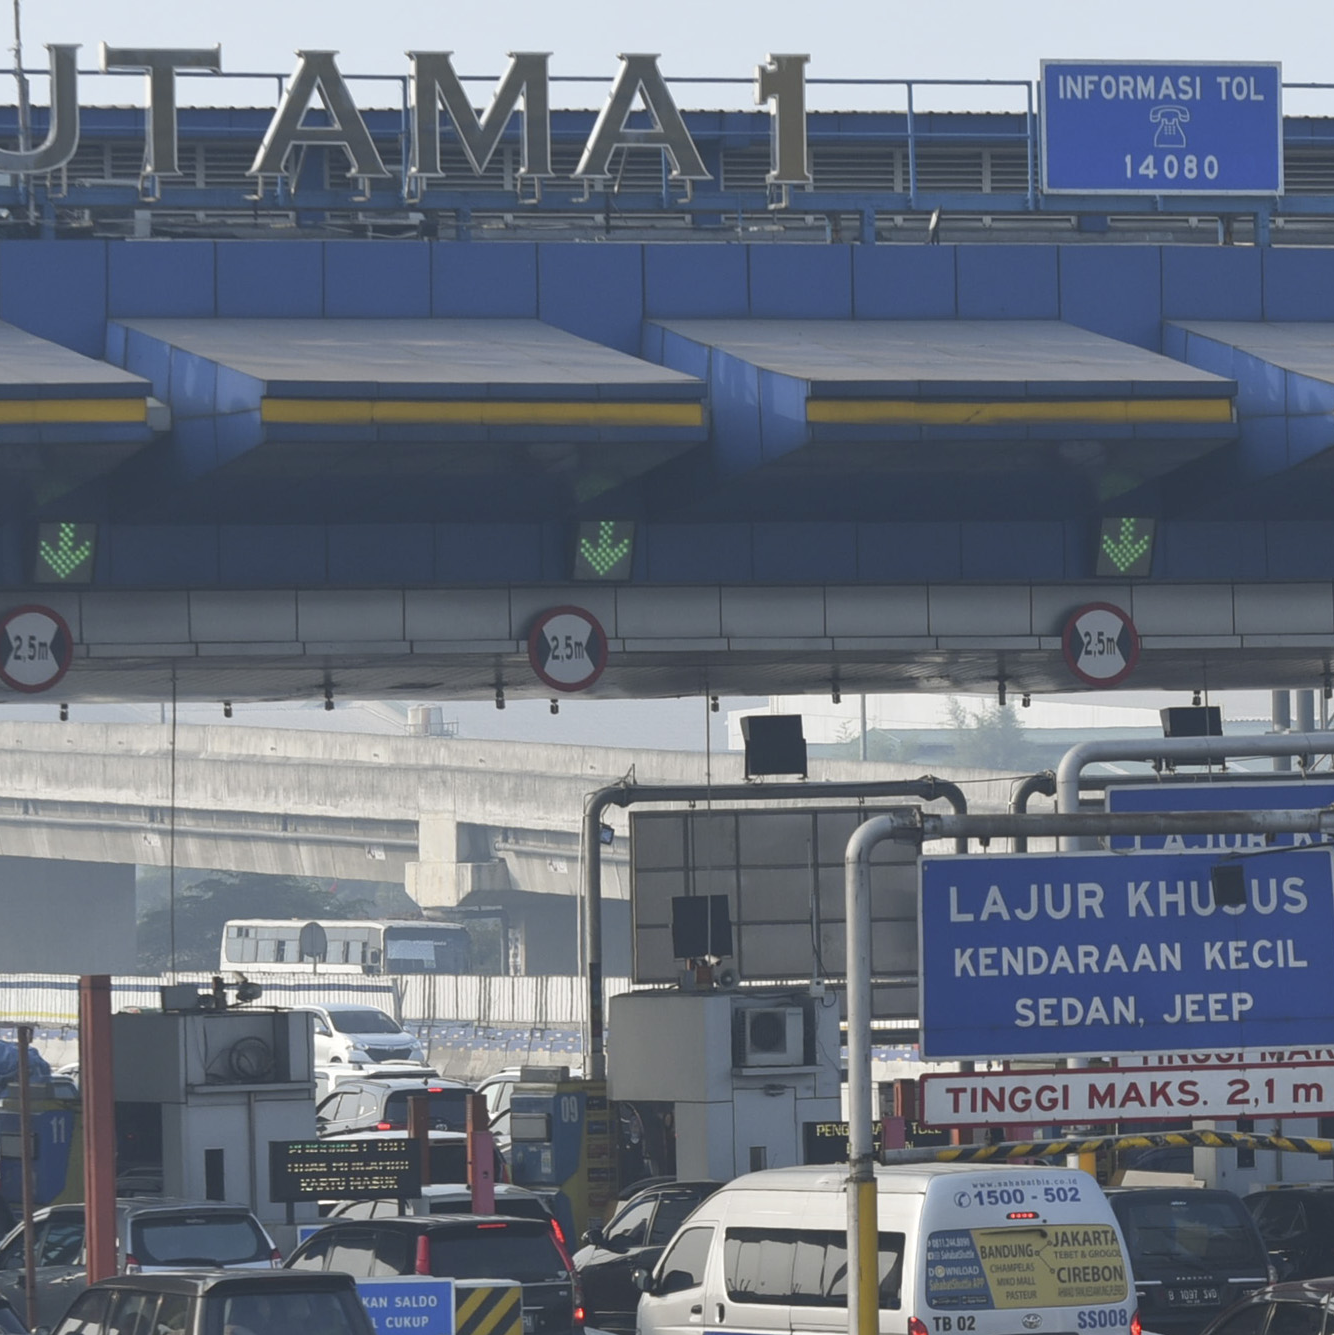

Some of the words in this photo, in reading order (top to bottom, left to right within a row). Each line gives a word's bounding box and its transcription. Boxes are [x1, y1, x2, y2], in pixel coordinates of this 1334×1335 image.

[1058, 75, 1201, 100] INFORMASI
[1216, 76, 1264, 101] TOL
[757, 54, 811, 185] 1
[1124, 154, 1218, 180] 14080
[949, 881, 1104, 923] LAJUR
[954, 942, 1184, 978] KENDARAAN
[1203, 938, 1308, 970] KECIL
[1014, 995, 1145, 1028] SEDAN,
[1162, 992, 1254, 1023] JEEP
[945, 1081, 1071, 1115] TINGGI
[1087, 1079, 1209, 1110] MAKS.
[1226, 1076, 1279, 1109] 2,1
[1292, 1082, 1324, 1104] m
[560, 1096, 579, 1123] 09
[51, 1117, 66, 1144] 11
[974, 1188, 1025, 1207] 1500
[1044, 1186, 1081, 1204] 502
[1052, 1229, 1119, 1248] JAKARTA
[980, 1244, 1033, 1261] BANDUNG
[1054, 1250, 1078, 1259] TEBET
[989, 1262, 1036, 1274] CIHAMPELAS
[1056, 1264, 1124, 1284] CIREBON
[1016, 1276, 1036, 1286] MALL
[394, 1295, 438, 1309] SALDO
[1006, 1290, 1037, 1300] PASTEUR
[385, 1316, 429, 1331] CUKUP
[933, 1317, 952, 1332] TB
[957, 1316, 976, 1331] 02
[1077, 1308, 1128, 1330] SS008
